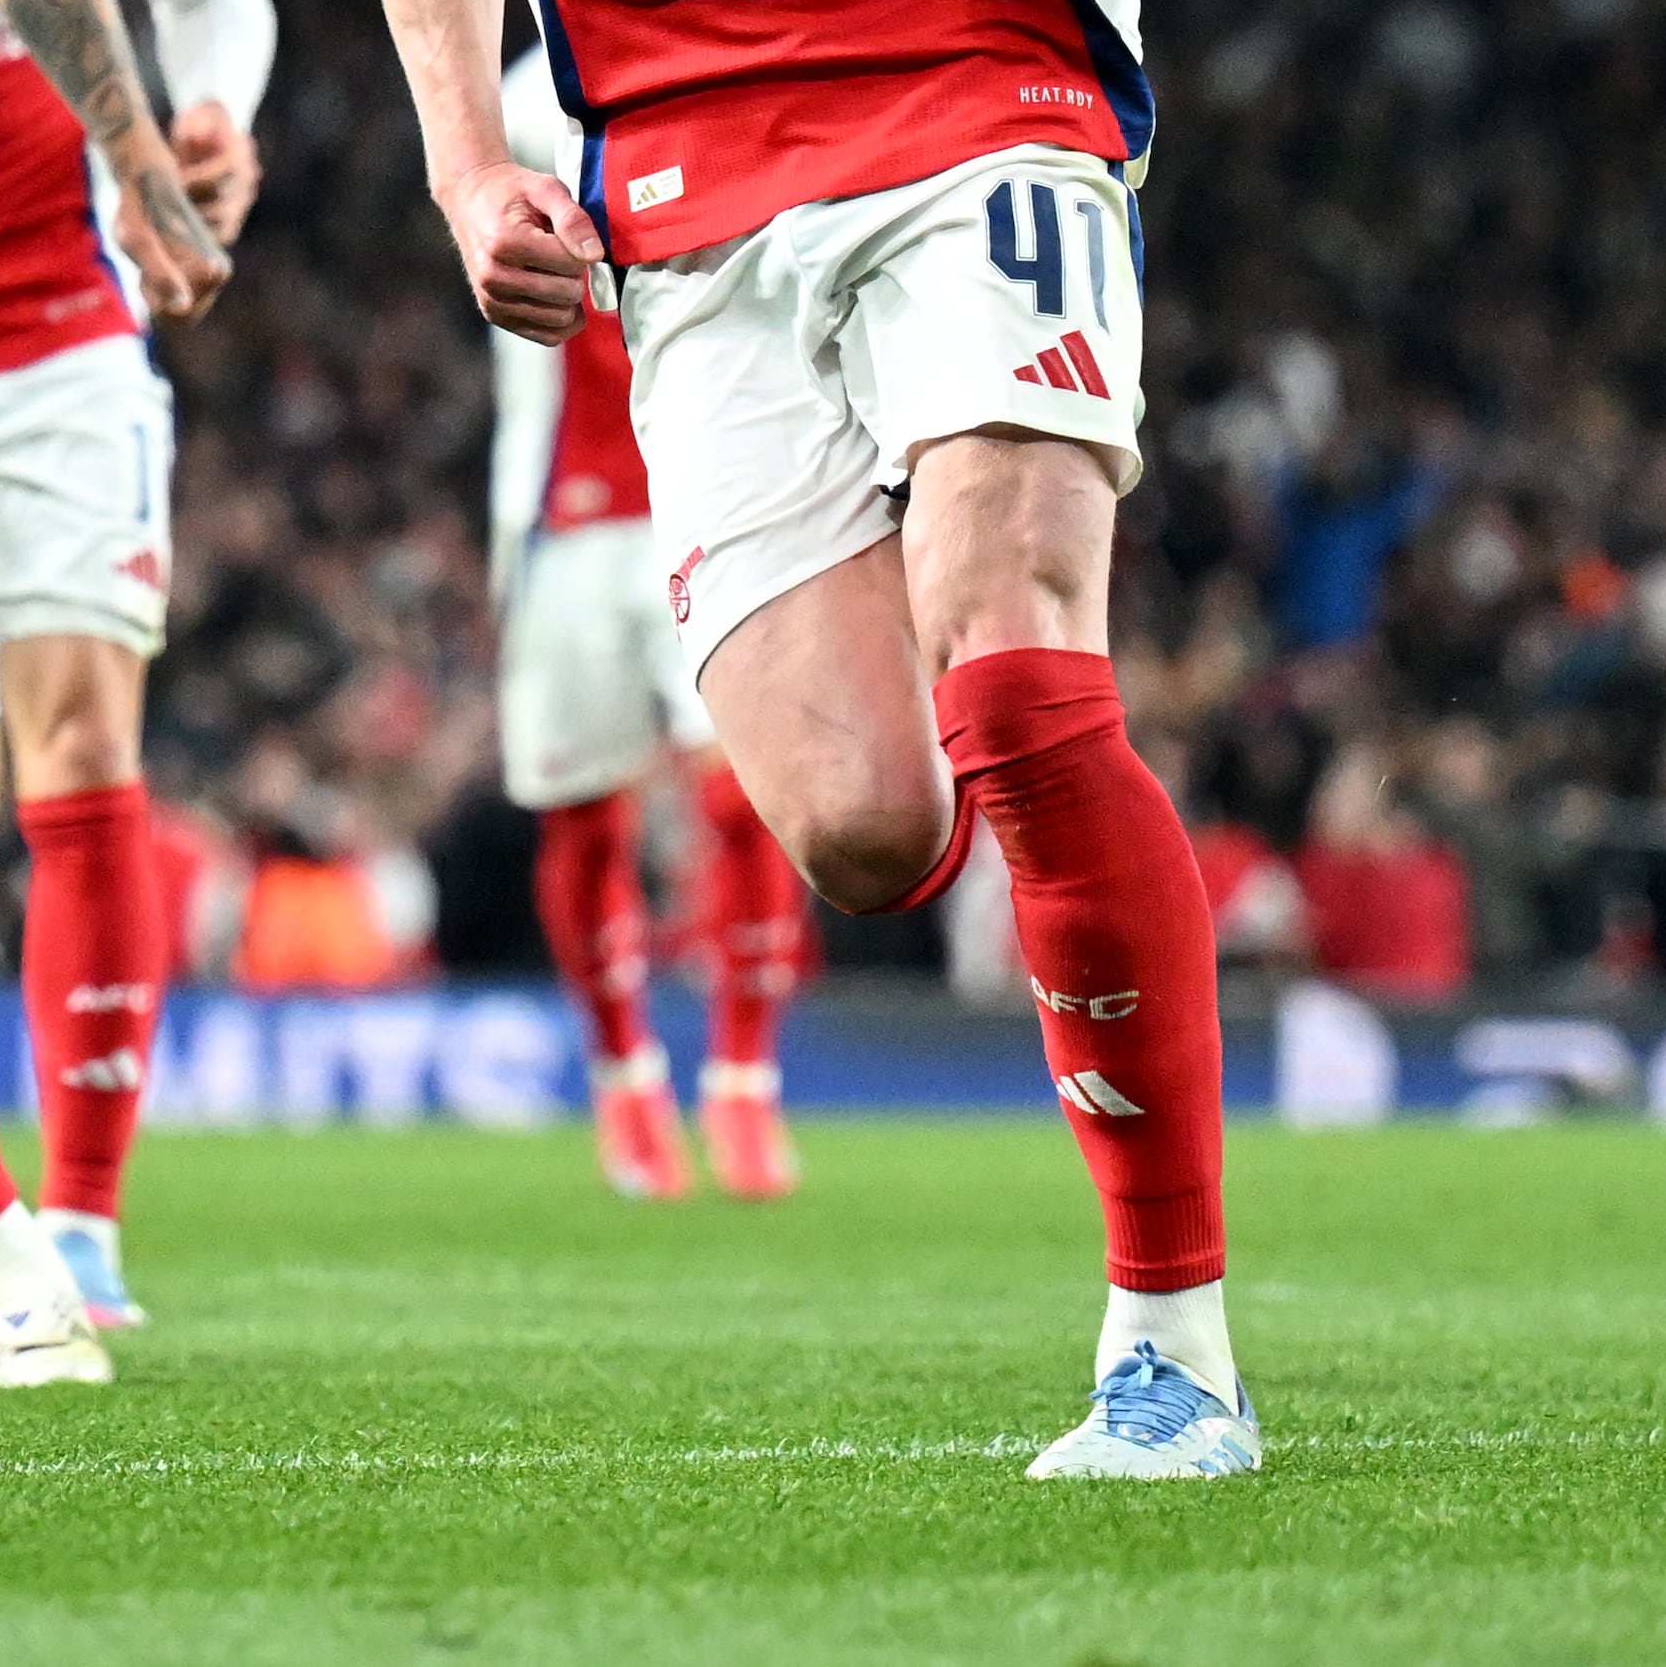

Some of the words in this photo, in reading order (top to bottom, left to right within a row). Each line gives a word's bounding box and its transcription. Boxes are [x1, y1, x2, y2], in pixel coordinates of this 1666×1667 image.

[1019, 86, 1094, 110] HEAT.RDY
[981, 178, 1111, 336] 41
[1030, 974, 1140, 1021] AFC
